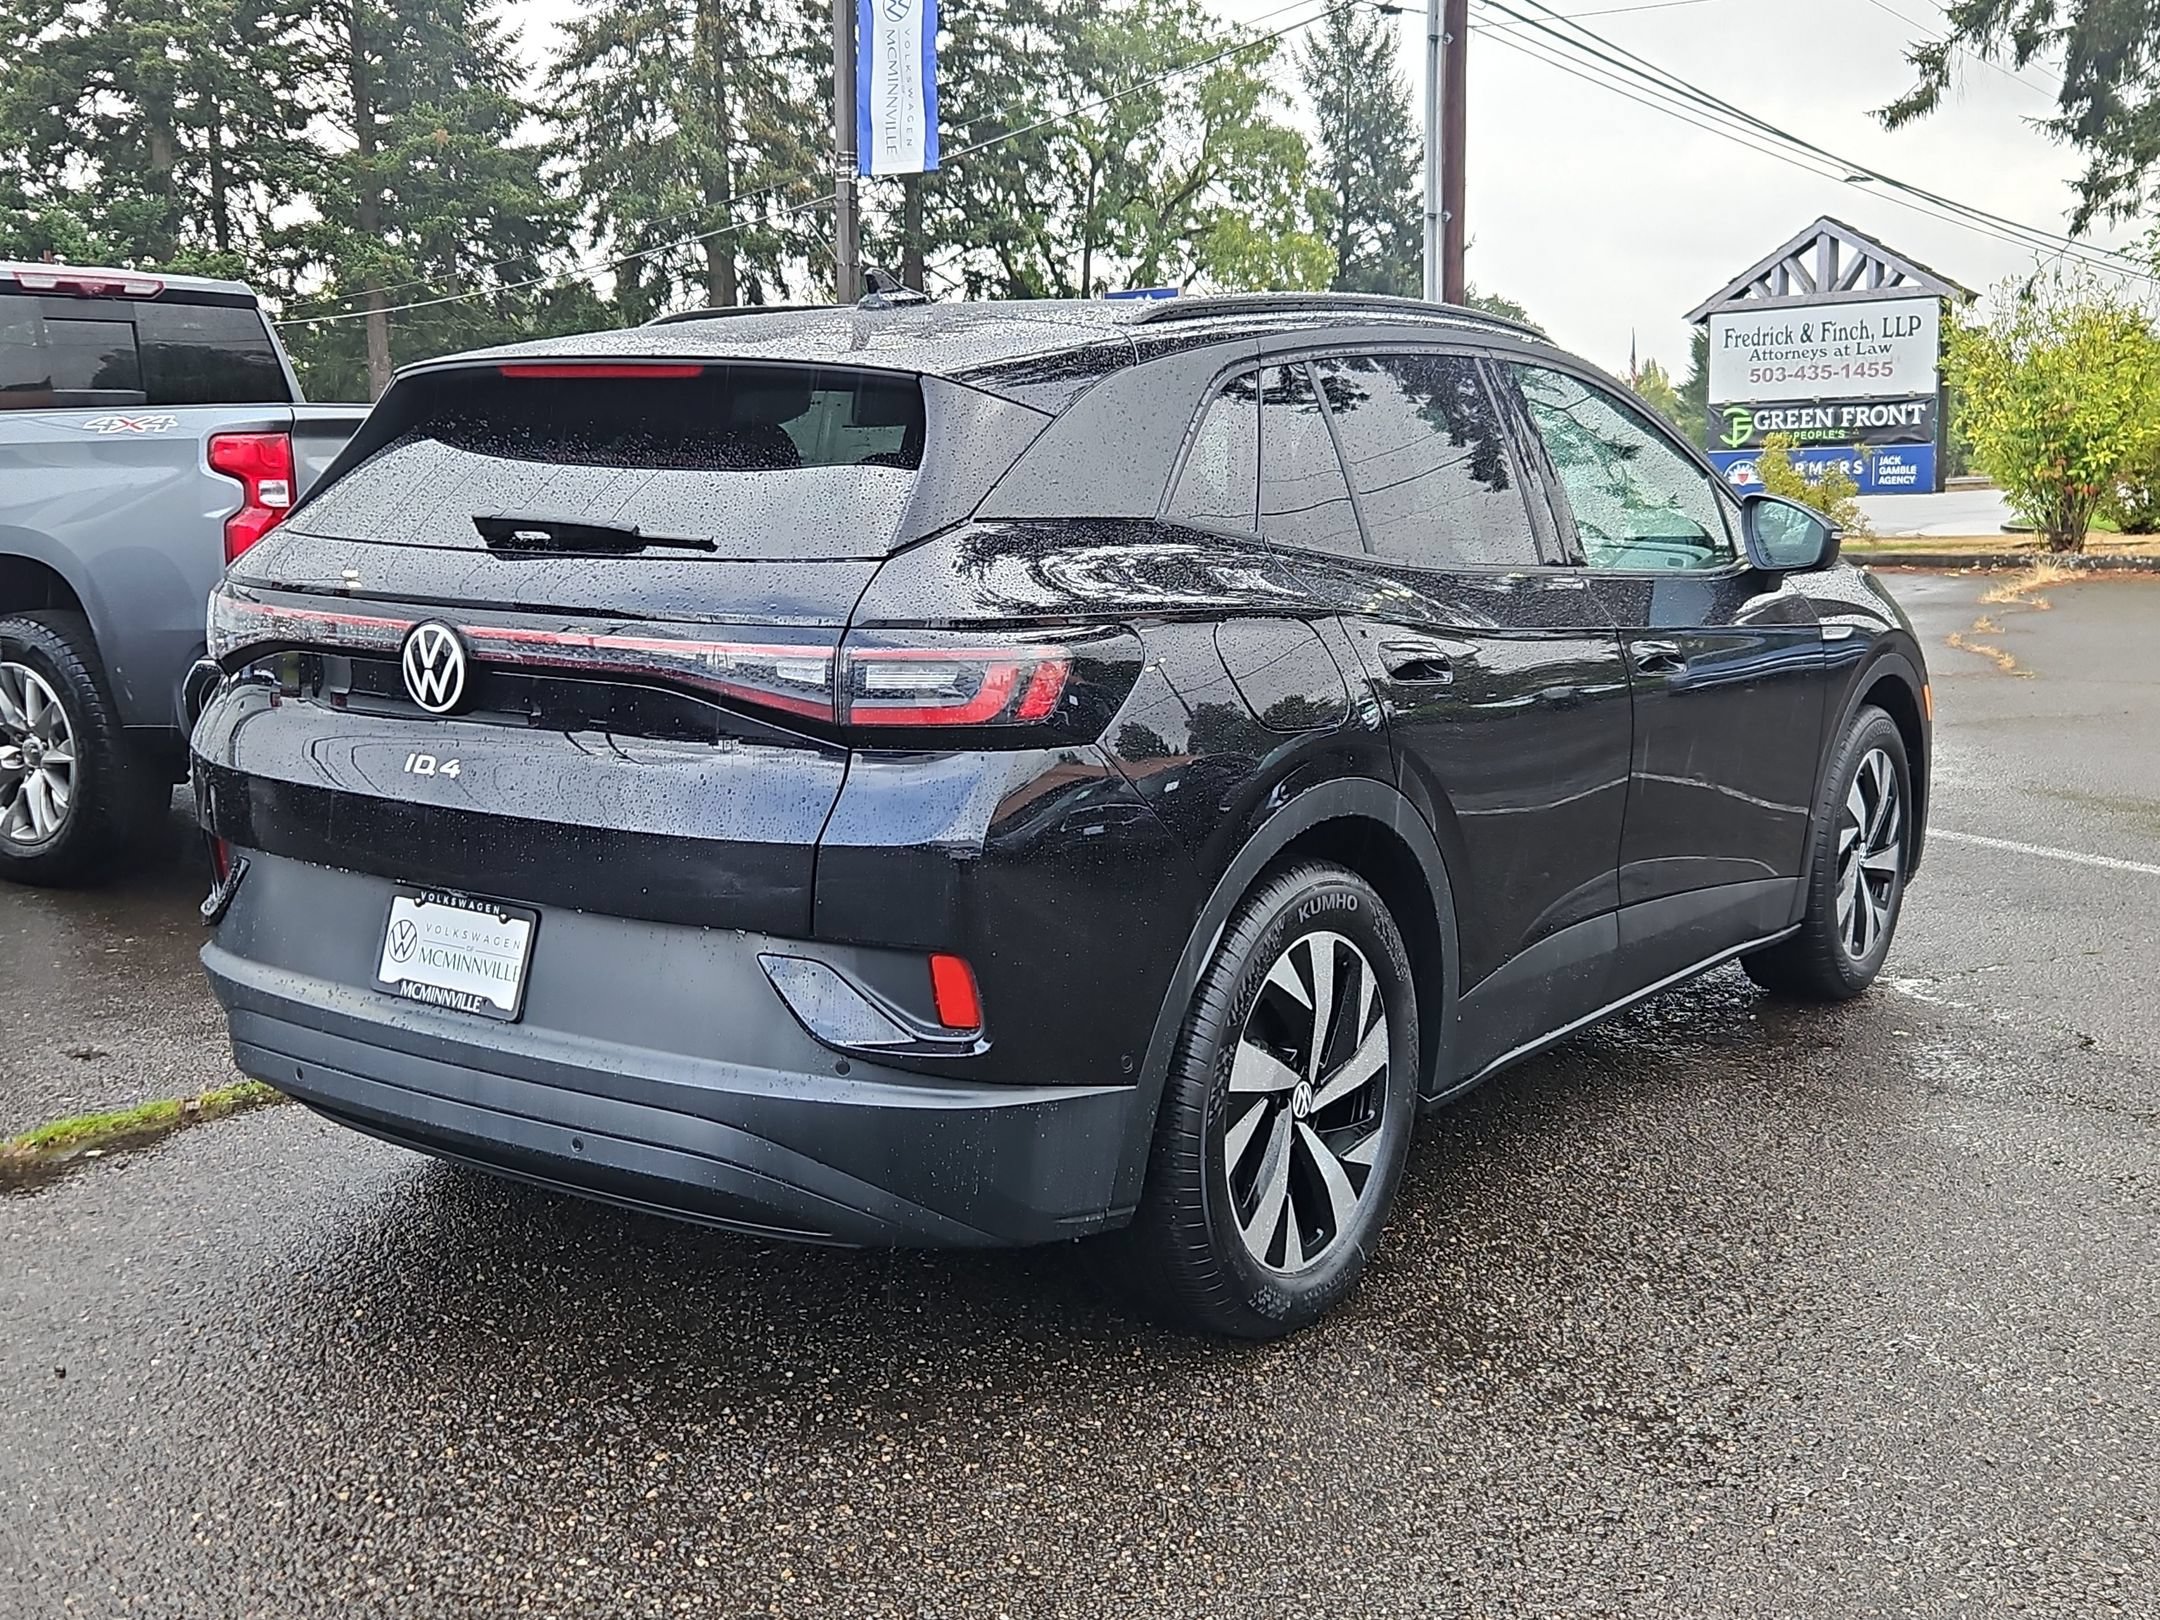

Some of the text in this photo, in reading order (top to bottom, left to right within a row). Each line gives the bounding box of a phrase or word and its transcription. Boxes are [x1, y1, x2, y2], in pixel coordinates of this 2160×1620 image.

[884, 28, 899, 156] MCMINNVILLE
[902, 27, 915, 147] VOLKSWAGEN
[1723, 315, 1922, 349] Fredrick & Finch, LLP
[1748, 341, 1893, 363] Attorneys at Law
[1749, 360, 1894, 384] 503-435-1455
[1753, 402, 1927, 431] GREEN FRONT
[1793, 428, 1846, 440] PEOPLE'S
[1878, 455, 1902, 466] JACK
[1878, 464, 1918, 476] GAMBLE
[1878, 474, 1916, 486] AGENCY
[420, 890, 501, 915] VOLKSWAGEN
[1297, 893, 1359, 924] KUMHO
[425, 922, 521, 950] VOLKSWAGEN
[399, 981, 483, 1013] MCMINNVILLE
